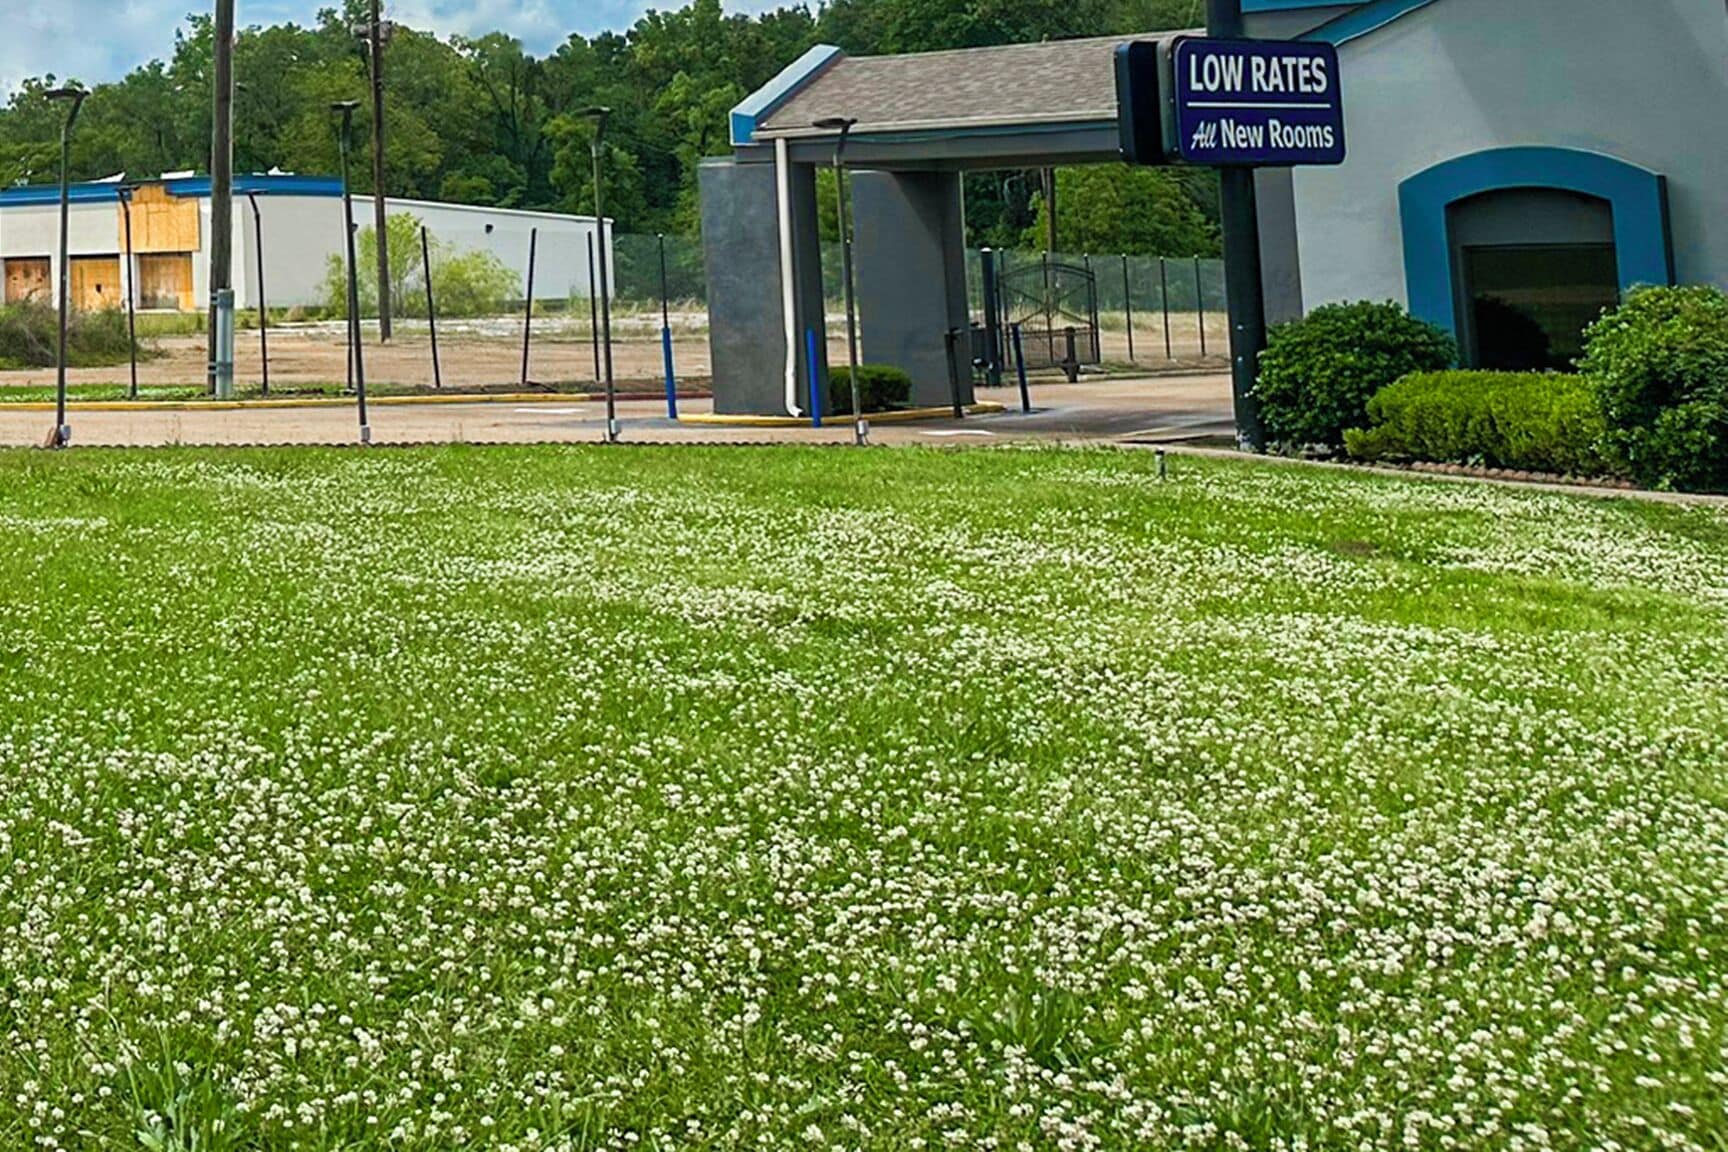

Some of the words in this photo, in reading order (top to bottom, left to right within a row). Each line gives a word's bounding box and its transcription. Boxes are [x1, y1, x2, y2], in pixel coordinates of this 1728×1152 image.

[1189, 53, 1244, 93] LOW
[1251, 55, 1328, 94] RATES
[1190, 120, 1218, 151] All
[1220, 117, 1264, 149] New
[1268, 118, 1335, 149] Rooms
